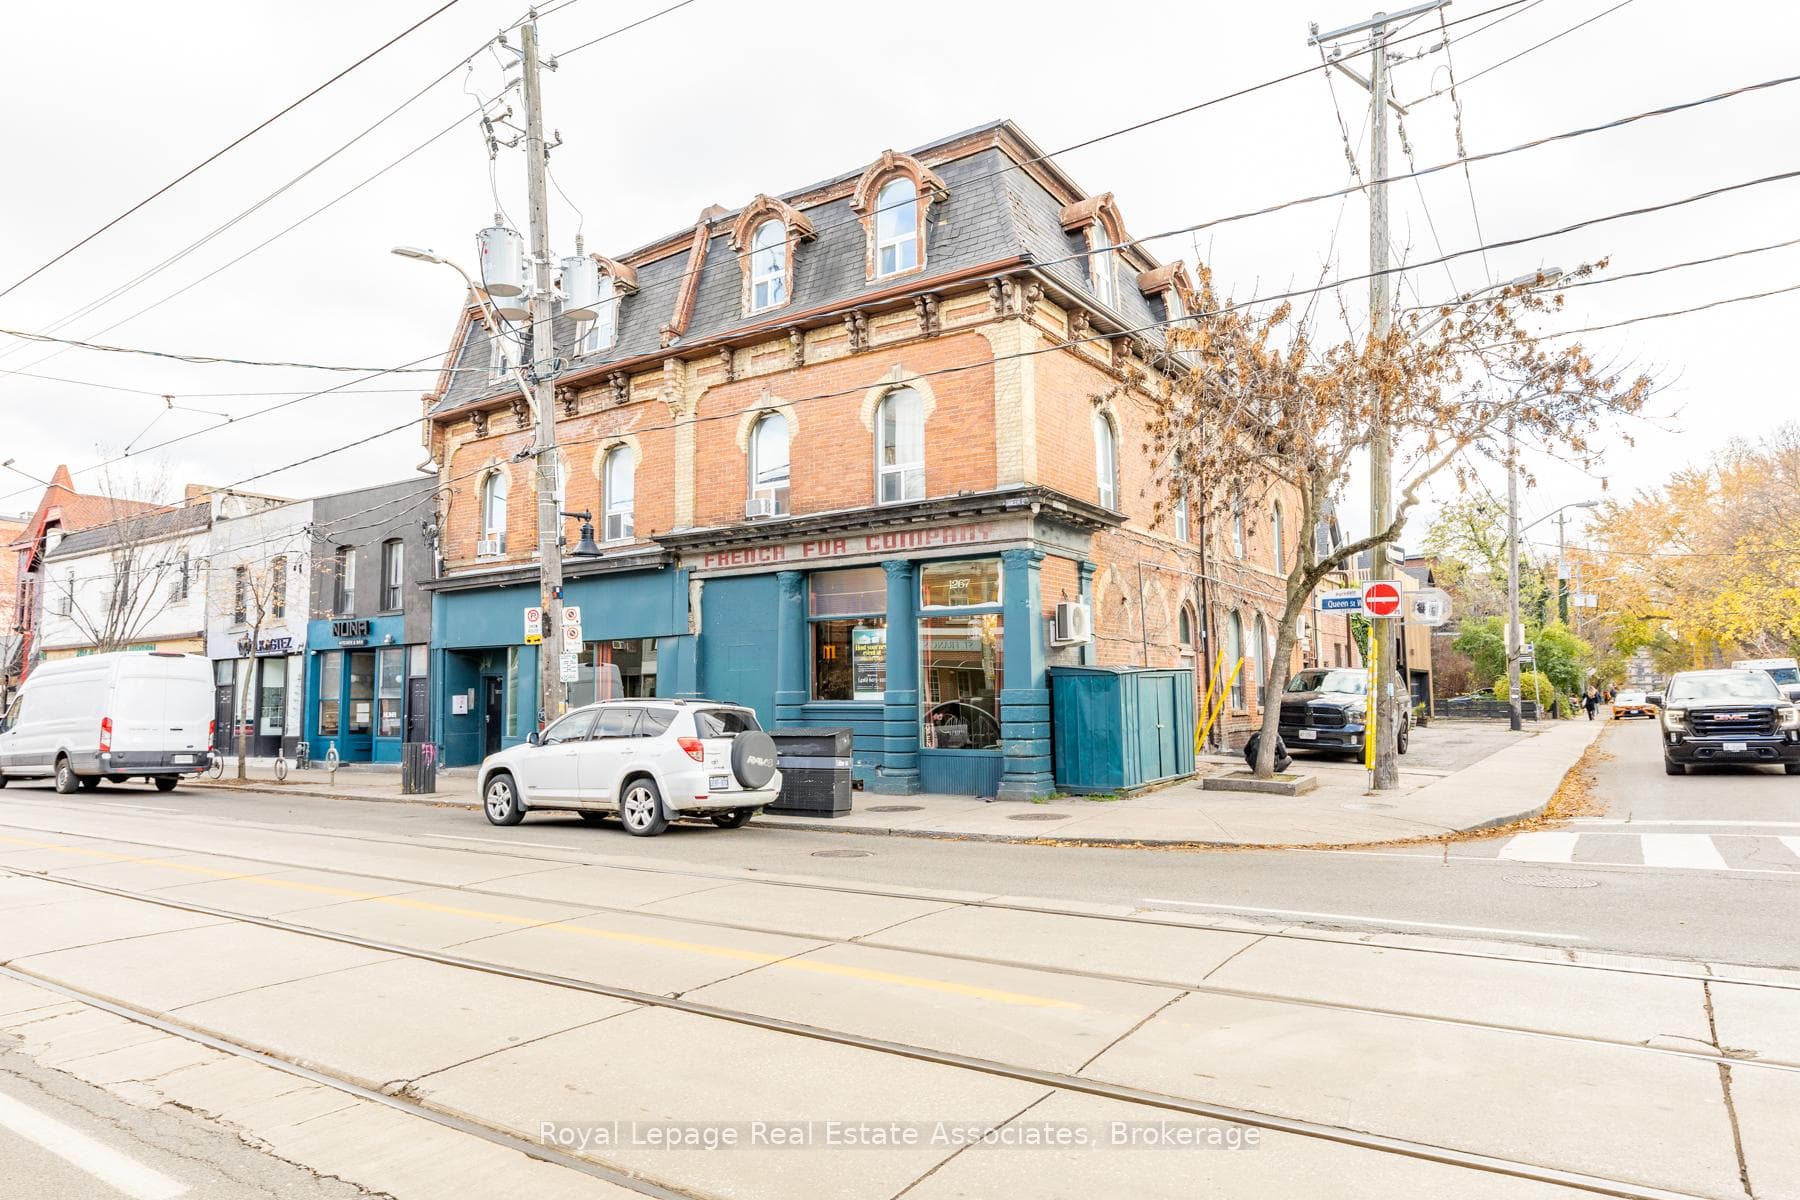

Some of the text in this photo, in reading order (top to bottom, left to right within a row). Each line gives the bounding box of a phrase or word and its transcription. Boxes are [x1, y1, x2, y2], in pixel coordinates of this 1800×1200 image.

[866, 522, 992, 551] COMPANY
[949, 578, 970, 589] 1267
[1328, 600, 1349, 609] Queen
[746, 755, 774, 768] RAV4
